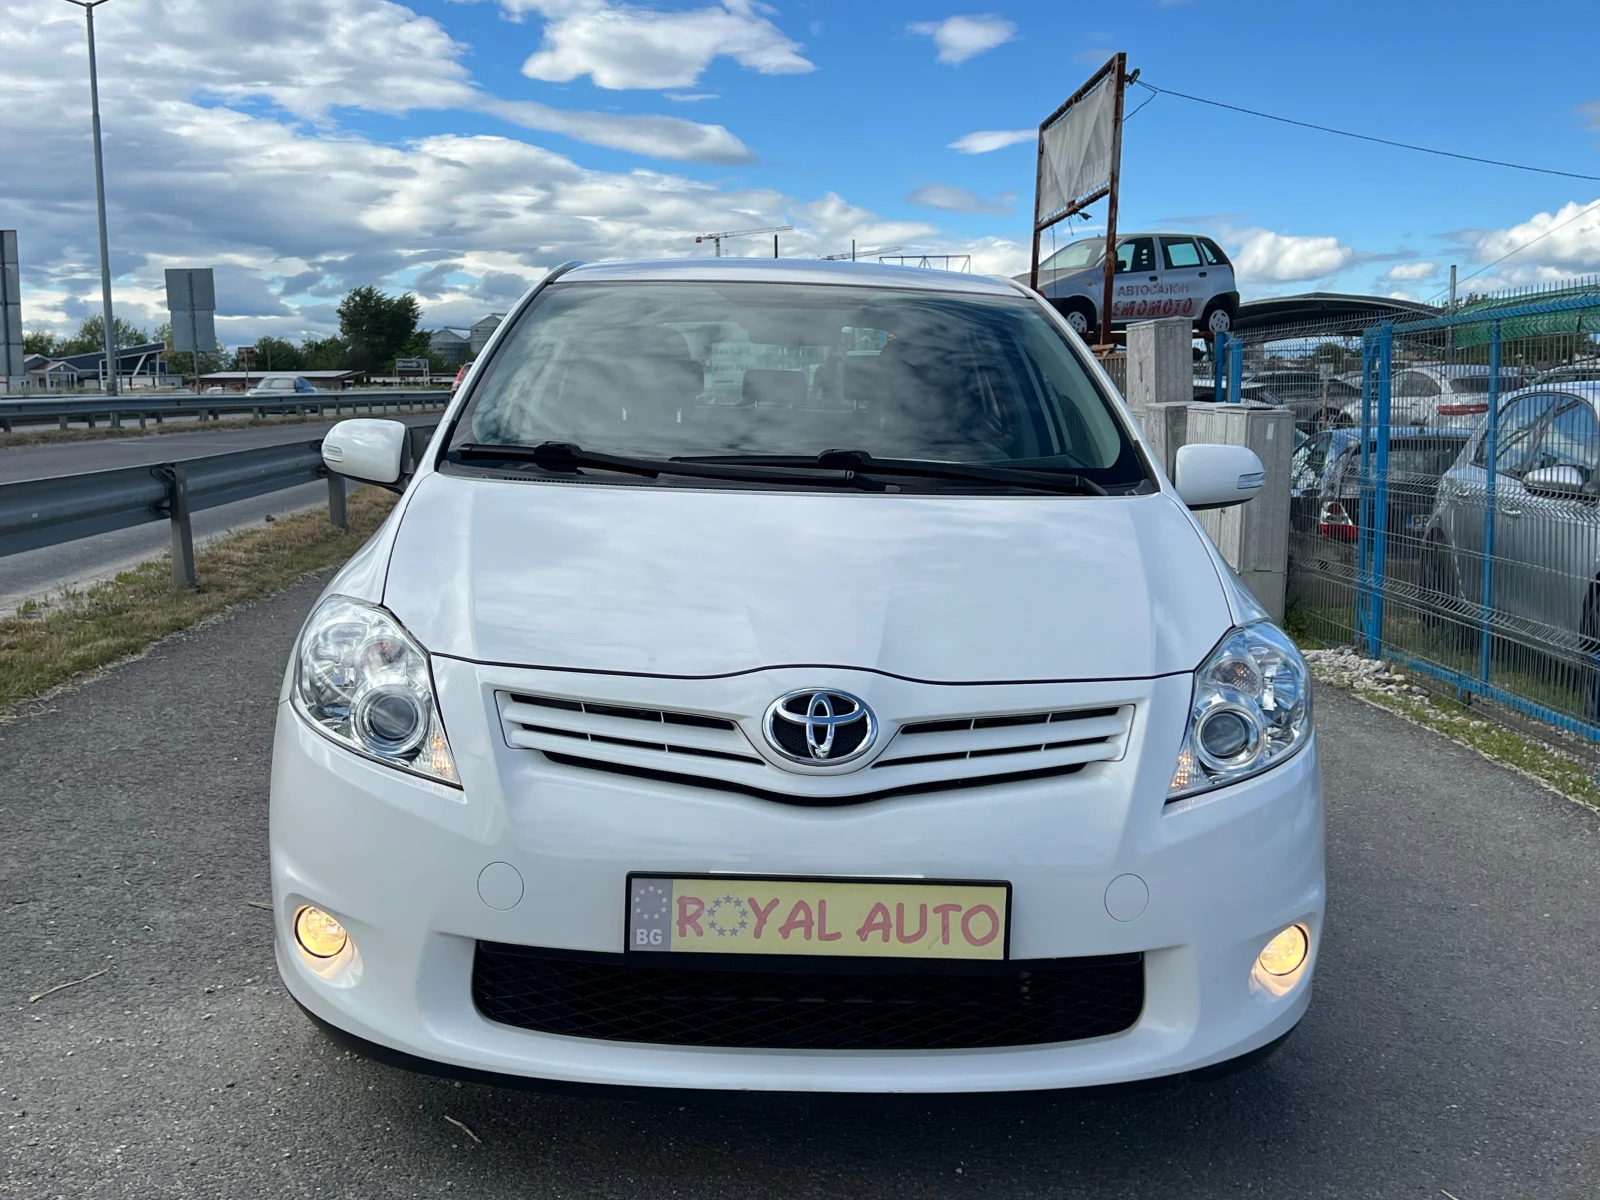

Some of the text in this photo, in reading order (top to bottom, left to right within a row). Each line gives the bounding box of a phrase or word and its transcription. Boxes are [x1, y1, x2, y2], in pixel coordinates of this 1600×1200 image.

[636, 928, 663, 945] BG
[676, 894, 1000, 947] ROYAL AUTO
